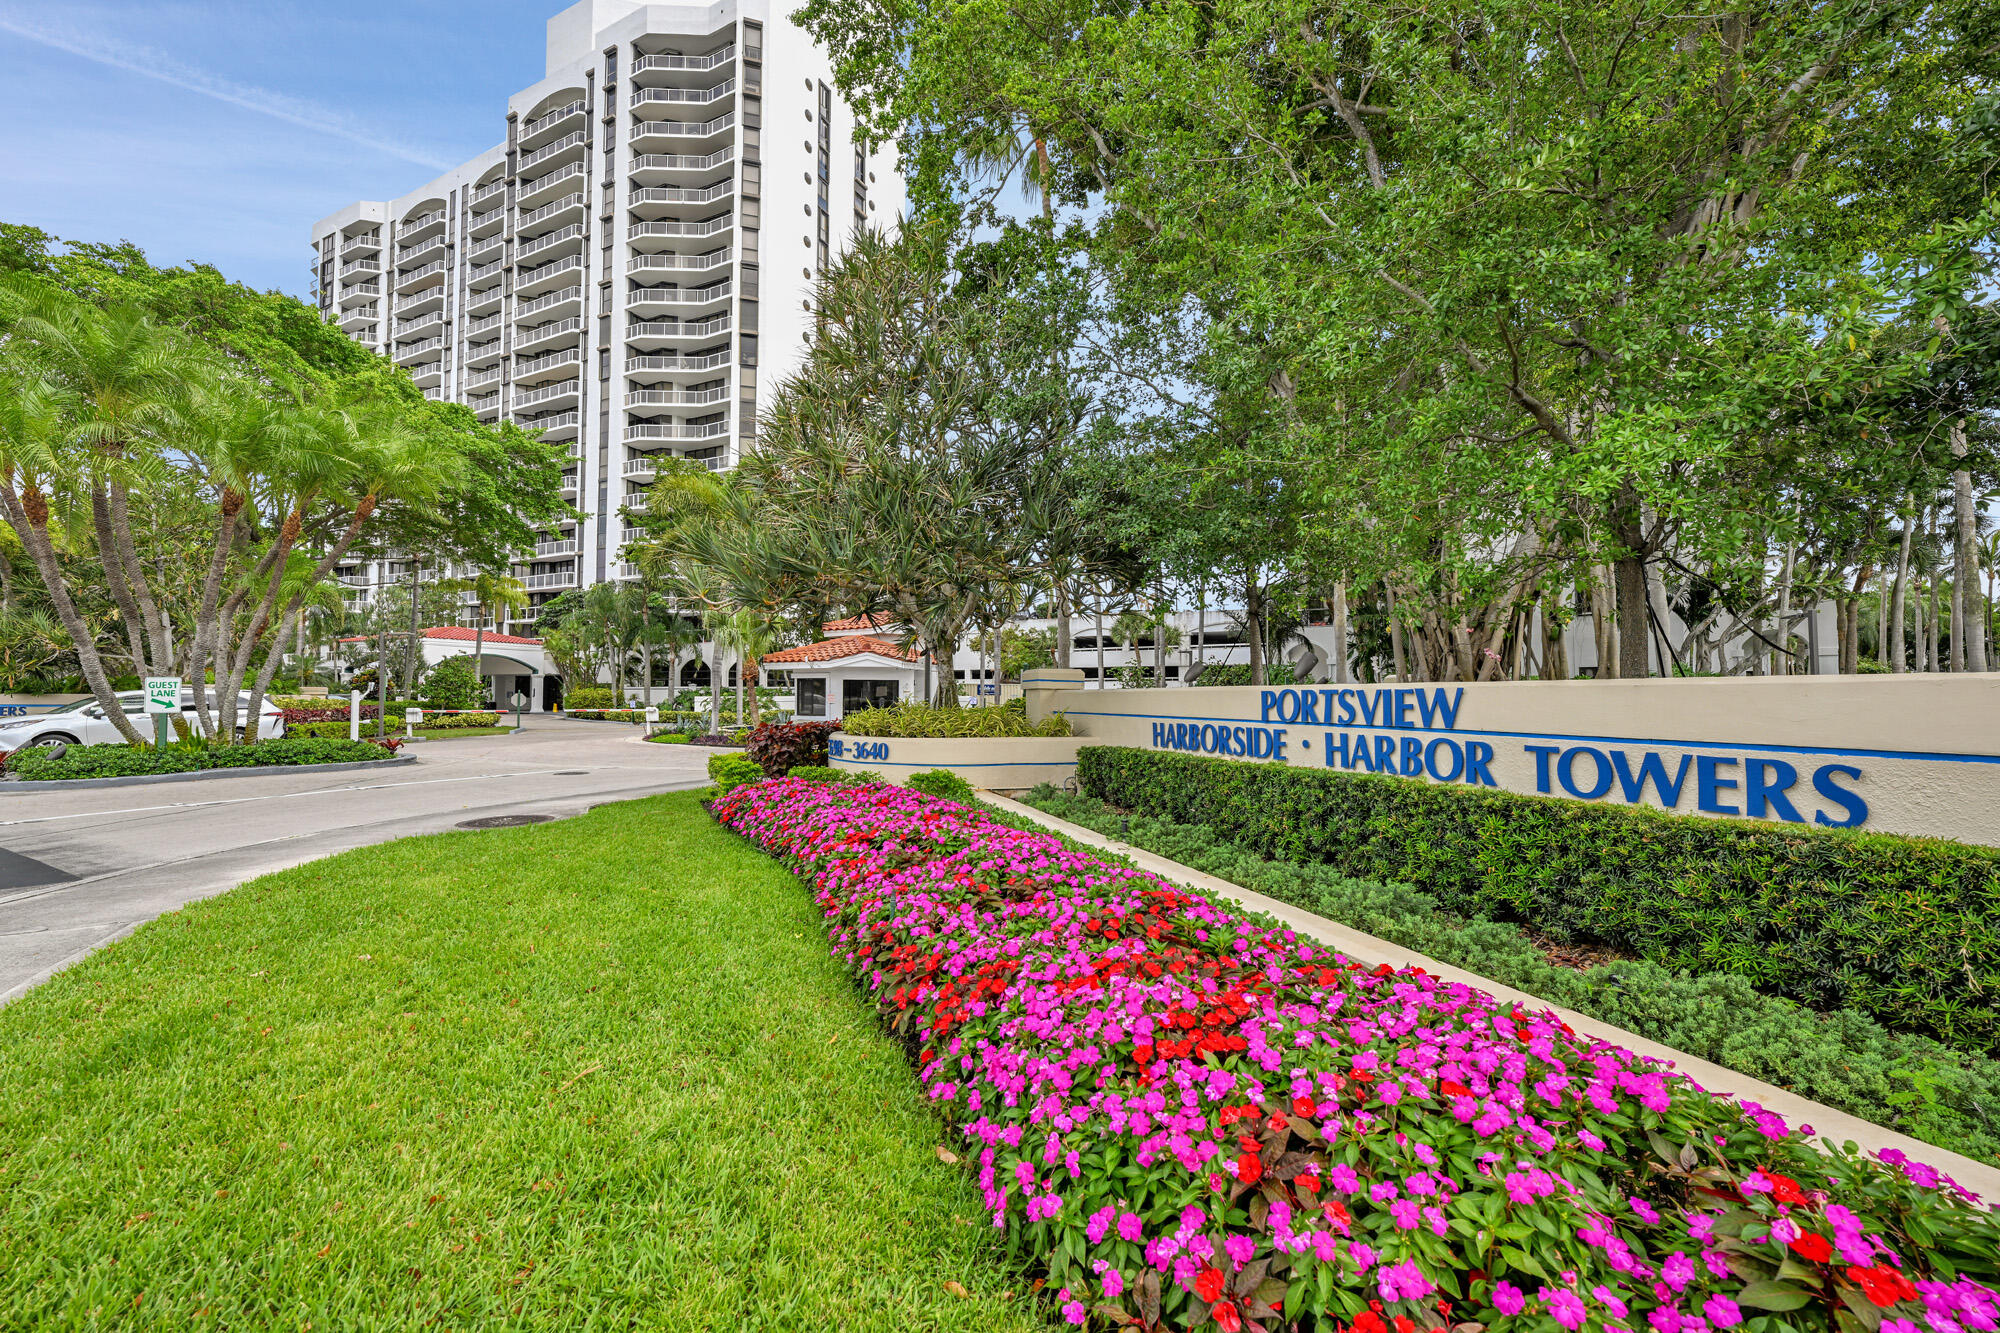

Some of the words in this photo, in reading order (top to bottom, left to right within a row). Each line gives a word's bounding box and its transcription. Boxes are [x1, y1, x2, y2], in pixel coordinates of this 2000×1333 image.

[148, 681, 178, 689] GUEST
[1261, 687, 1464, 729] PORTSVIEW
[1152, 722, 1287, 761] HARBORSIDE
[1324, 732, 1498, 787] HARBOR
[1524, 745, 1869, 829] TOWERS
